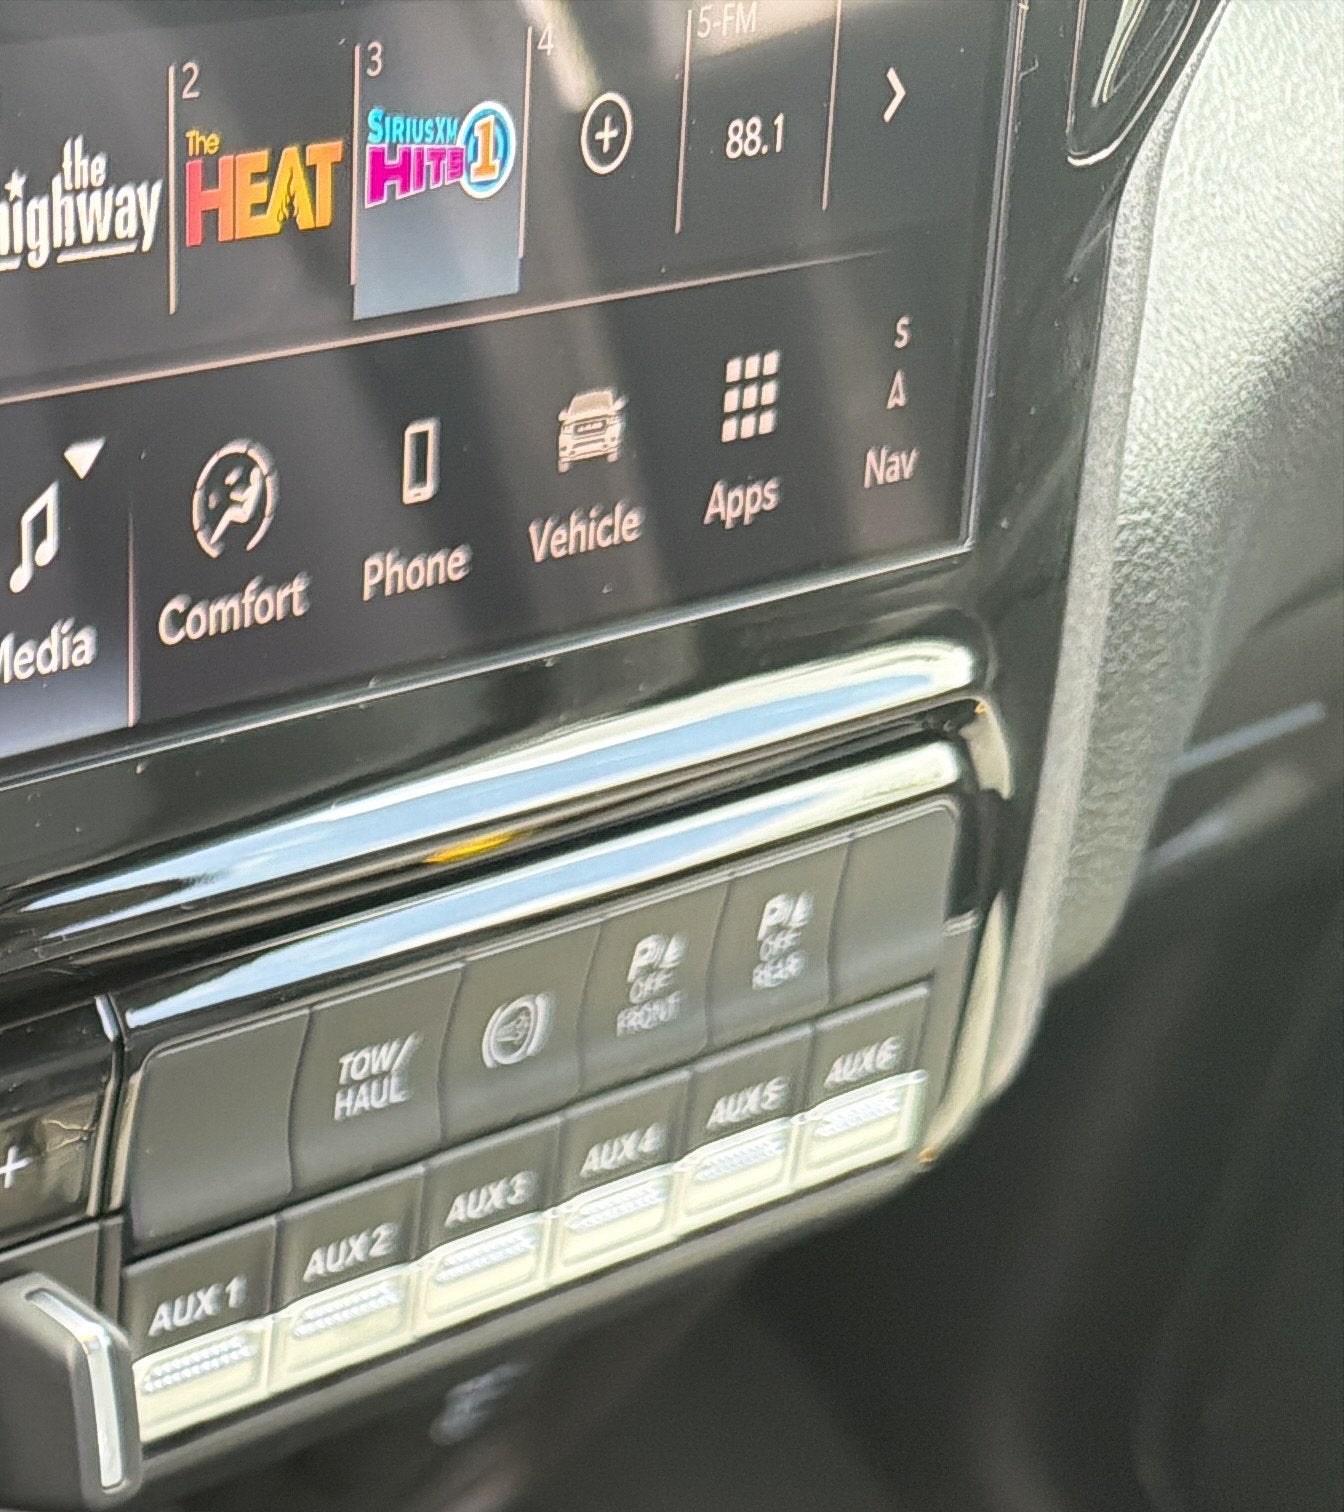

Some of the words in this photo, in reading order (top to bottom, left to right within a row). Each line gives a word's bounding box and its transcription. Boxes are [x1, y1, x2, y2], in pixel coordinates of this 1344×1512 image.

[697, 2, 758, 38] 5-FM
[182, 62, 201, 99] 2
[366, 41, 383, 77] 3
[62, 133, 108, 190] the
[185, 129, 222, 157] The
[725, 112, 785, 159] 88.1
[185, 139, 345, 248] HEAT
[365, 144, 466, 209] HITS
[863, 445, 920, 489] Nav
[703, 475, 781, 531] Apps
[528, 500, 643, 564] Vehicle
[363, 541, 473, 601] Phone
[158, 570, 311, 647] Comfort
[338, 1031, 420, 1085] TOW/
[333, 1071, 410, 1121] HAUL
[303, 1229, 372, 1283] AUX
[147, 1282, 223, 1337] AUX
[225, 1273, 248, 1309] 1
